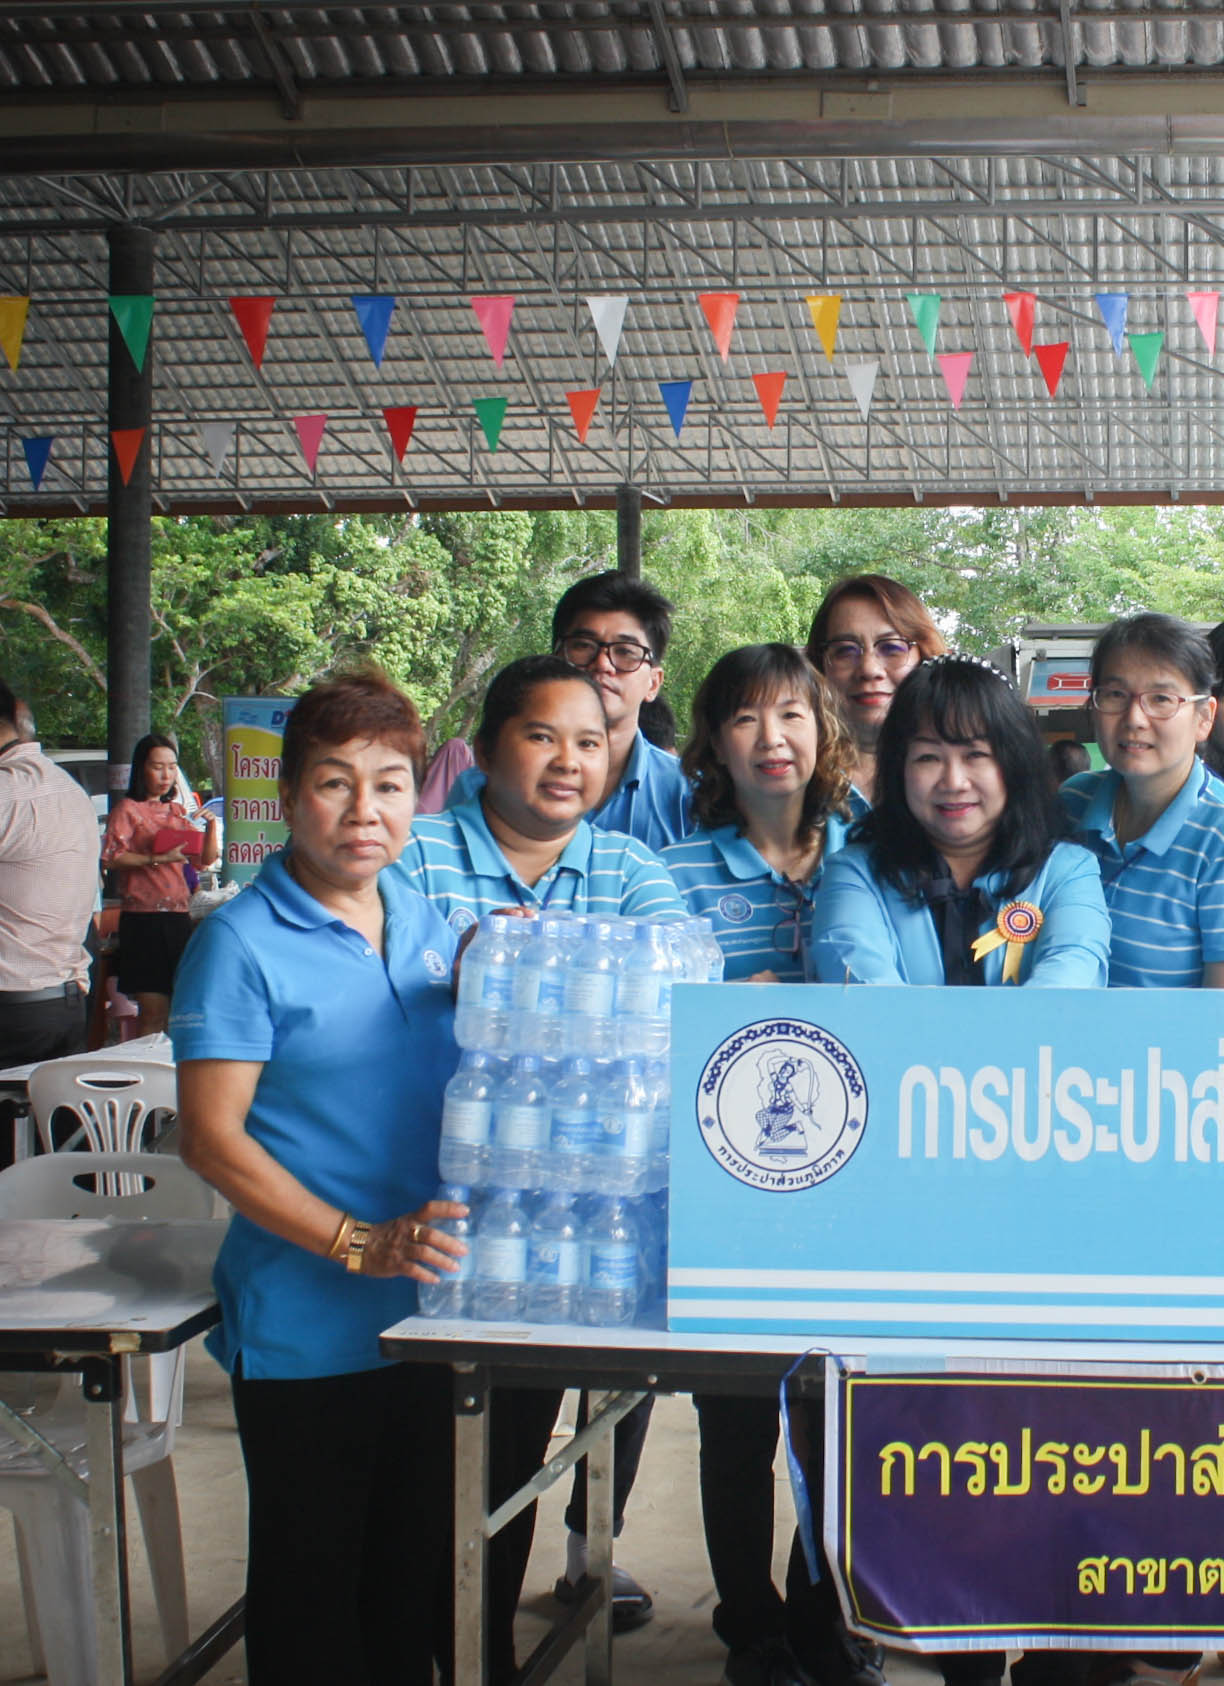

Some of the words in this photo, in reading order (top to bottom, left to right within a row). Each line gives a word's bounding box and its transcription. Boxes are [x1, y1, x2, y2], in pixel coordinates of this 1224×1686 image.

[231, 743, 281, 778] โครงก
[231, 797, 284, 822] ราคาป
[717, 1145, 846, 1187] การประปาส่วนภูมิภาค
